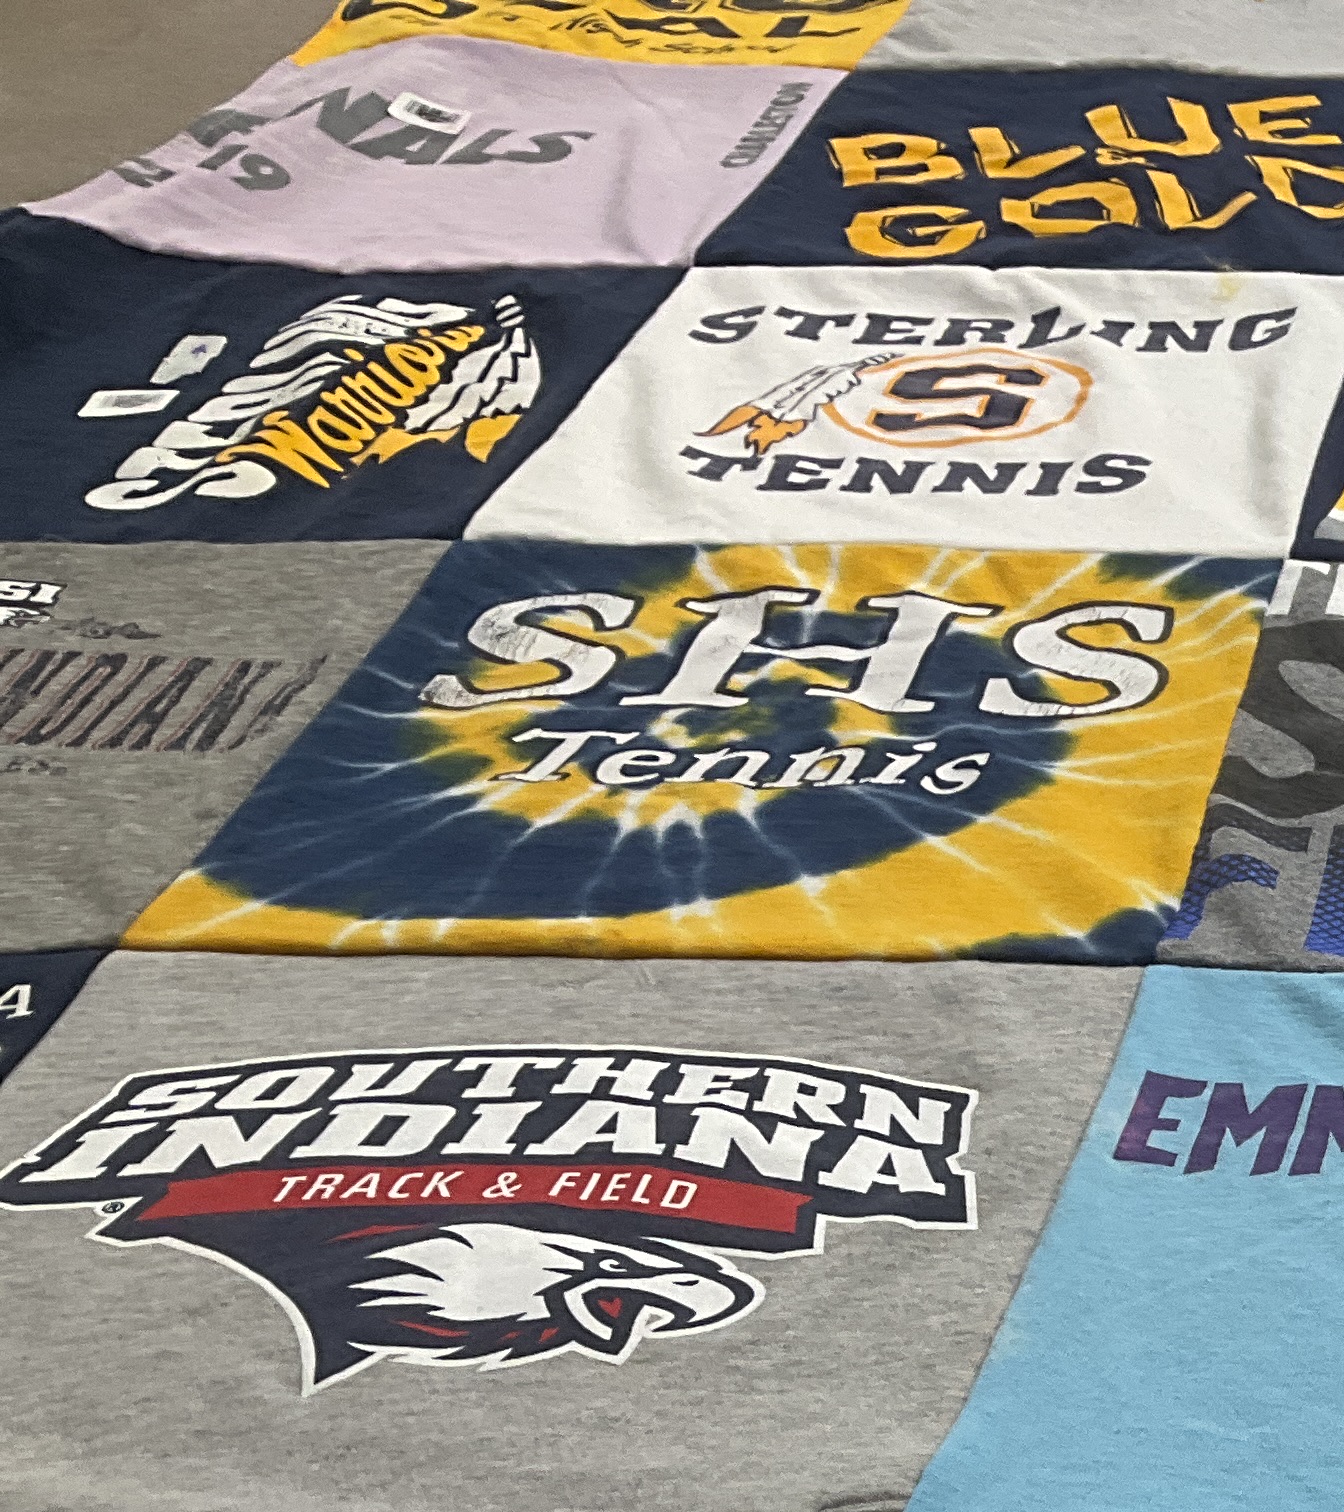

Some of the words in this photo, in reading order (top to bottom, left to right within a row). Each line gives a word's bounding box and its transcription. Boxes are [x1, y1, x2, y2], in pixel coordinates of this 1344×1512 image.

[827, 95, 1343, 187] BLUE
[688, 305, 1298, 354] STERLING
[870, 364, 1046, 432] S
[678, 445, 1155, 496] TENNIS
[418, 588, 1176, 720] SHS
[494, 728, 992, 794] Tennis
[98, 1056, 955, 1146] SOUTHERN
[20, 1102, 948, 1197] INDIANA
[272, 1172, 470, 1206] TRACK
[480, 1173, 524, 1200] &
[546, 1172, 698, 1212] FIELD
